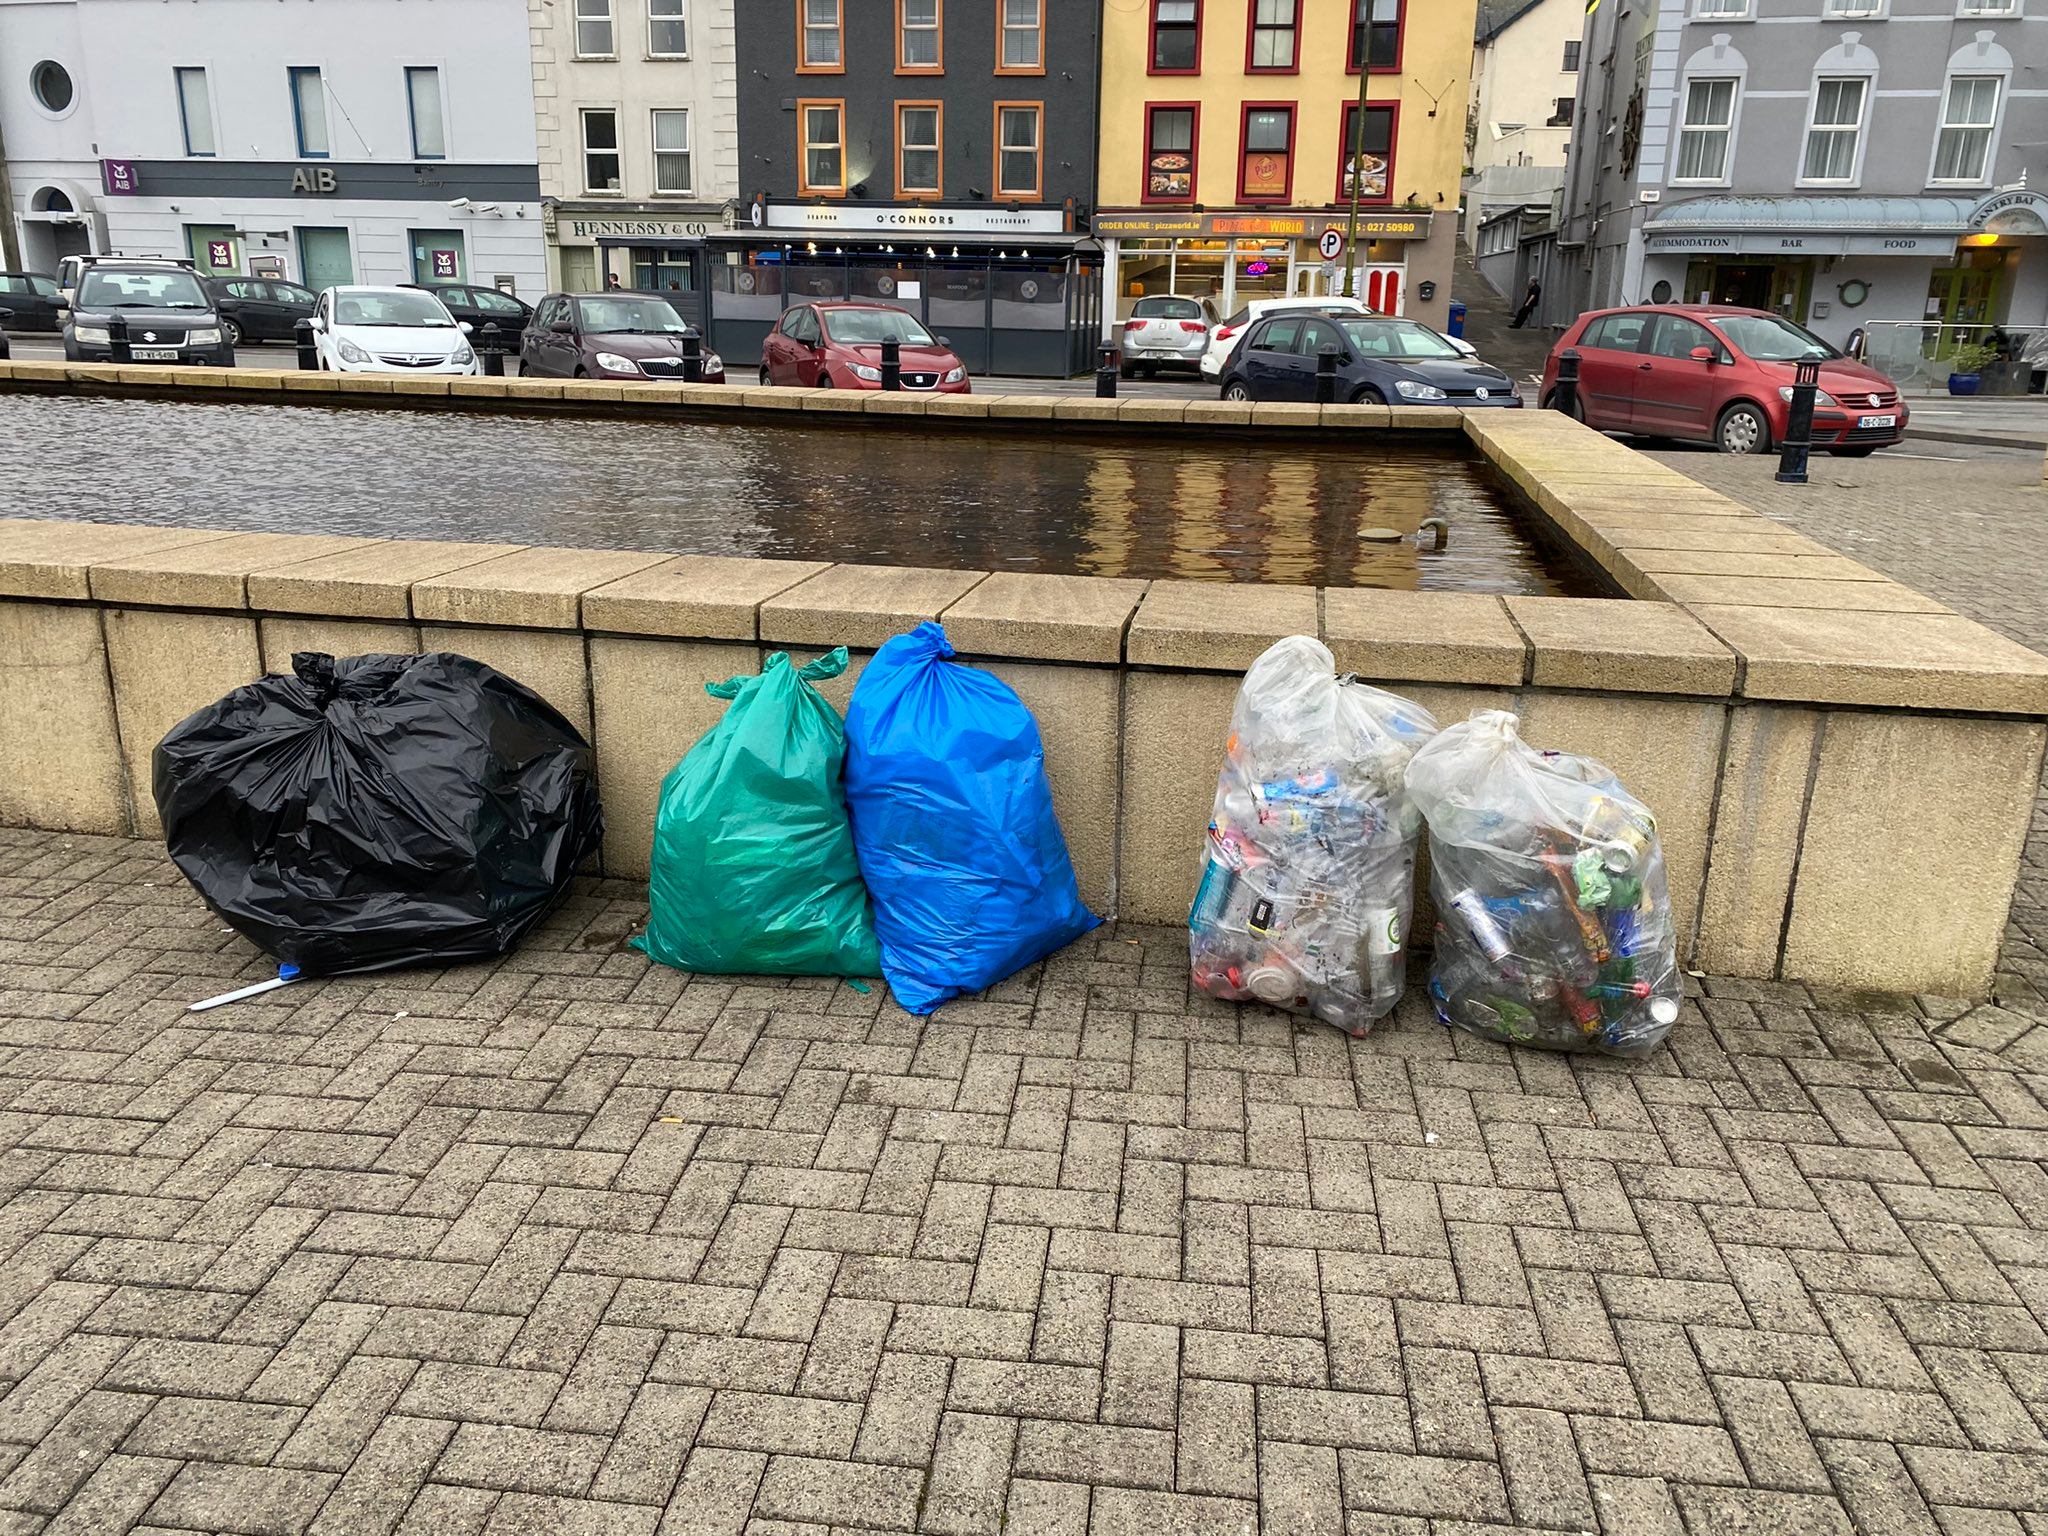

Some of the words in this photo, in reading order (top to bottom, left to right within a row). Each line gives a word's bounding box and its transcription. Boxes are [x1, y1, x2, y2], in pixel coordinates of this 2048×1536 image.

[115, 180, 130, 190] AIB
[291, 168, 337, 192] AIB
[1974, 196, 2014, 227] BANTRY
[2015, 195, 2037, 205] BAY
[876, 214, 954, 225] O'CONNORS
[985, 217, 1031, 225] RESTAURANT
[573, 221, 668, 236] HENNESSY
[672, 224, 682, 234] &
[1098, 221, 1123, 230] ORDER
[1124, 222, 1150, 230] ONLINE
[1155, 221, 1200, 231] pizzaworld.ie
[1270, 219, 1303, 233] WORLD
[1326, 222, 1347, 232] CALL
[1367, 222, 1383, 232] 027
[1386, 222, 1415, 232] 50980
[1781, 239, 1803, 248] BAR
[1884, 239, 1917, 249] FOOD
[214, 256, 228, 265] AIB
[438, 266, 453, 275] AIB
